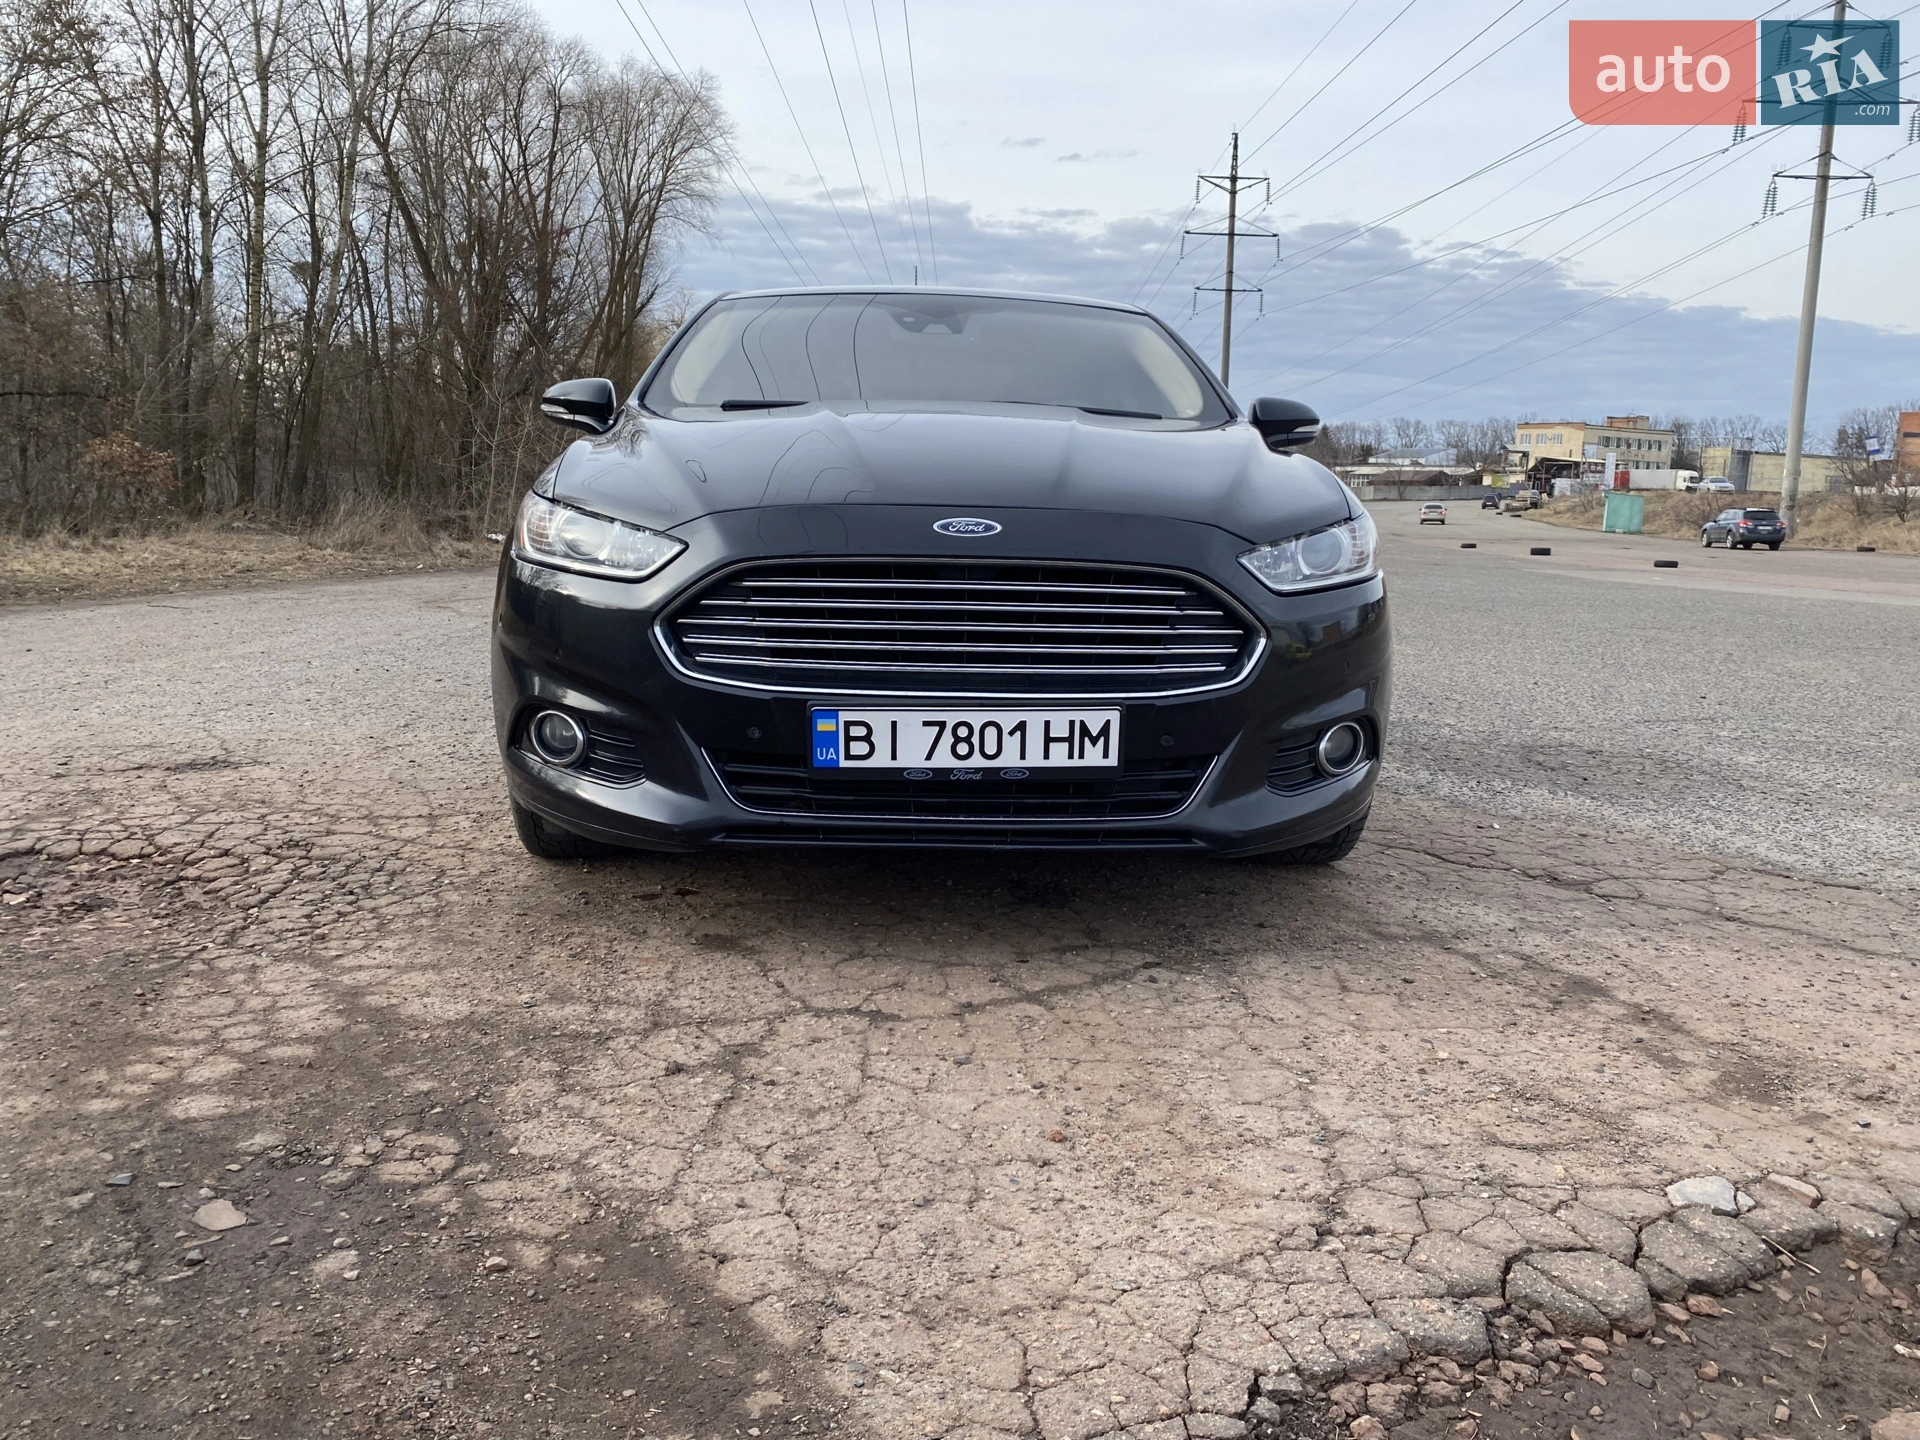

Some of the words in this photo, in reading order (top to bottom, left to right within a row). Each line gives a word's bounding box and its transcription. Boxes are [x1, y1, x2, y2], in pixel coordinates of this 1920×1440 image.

[843, 720, 898, 761] BI
[921, 720, 1027, 761] 7801
[1043, 719, 1111, 760] HM
[816, 747, 837, 760] UA
[950, 768, 984, 780] Ford
